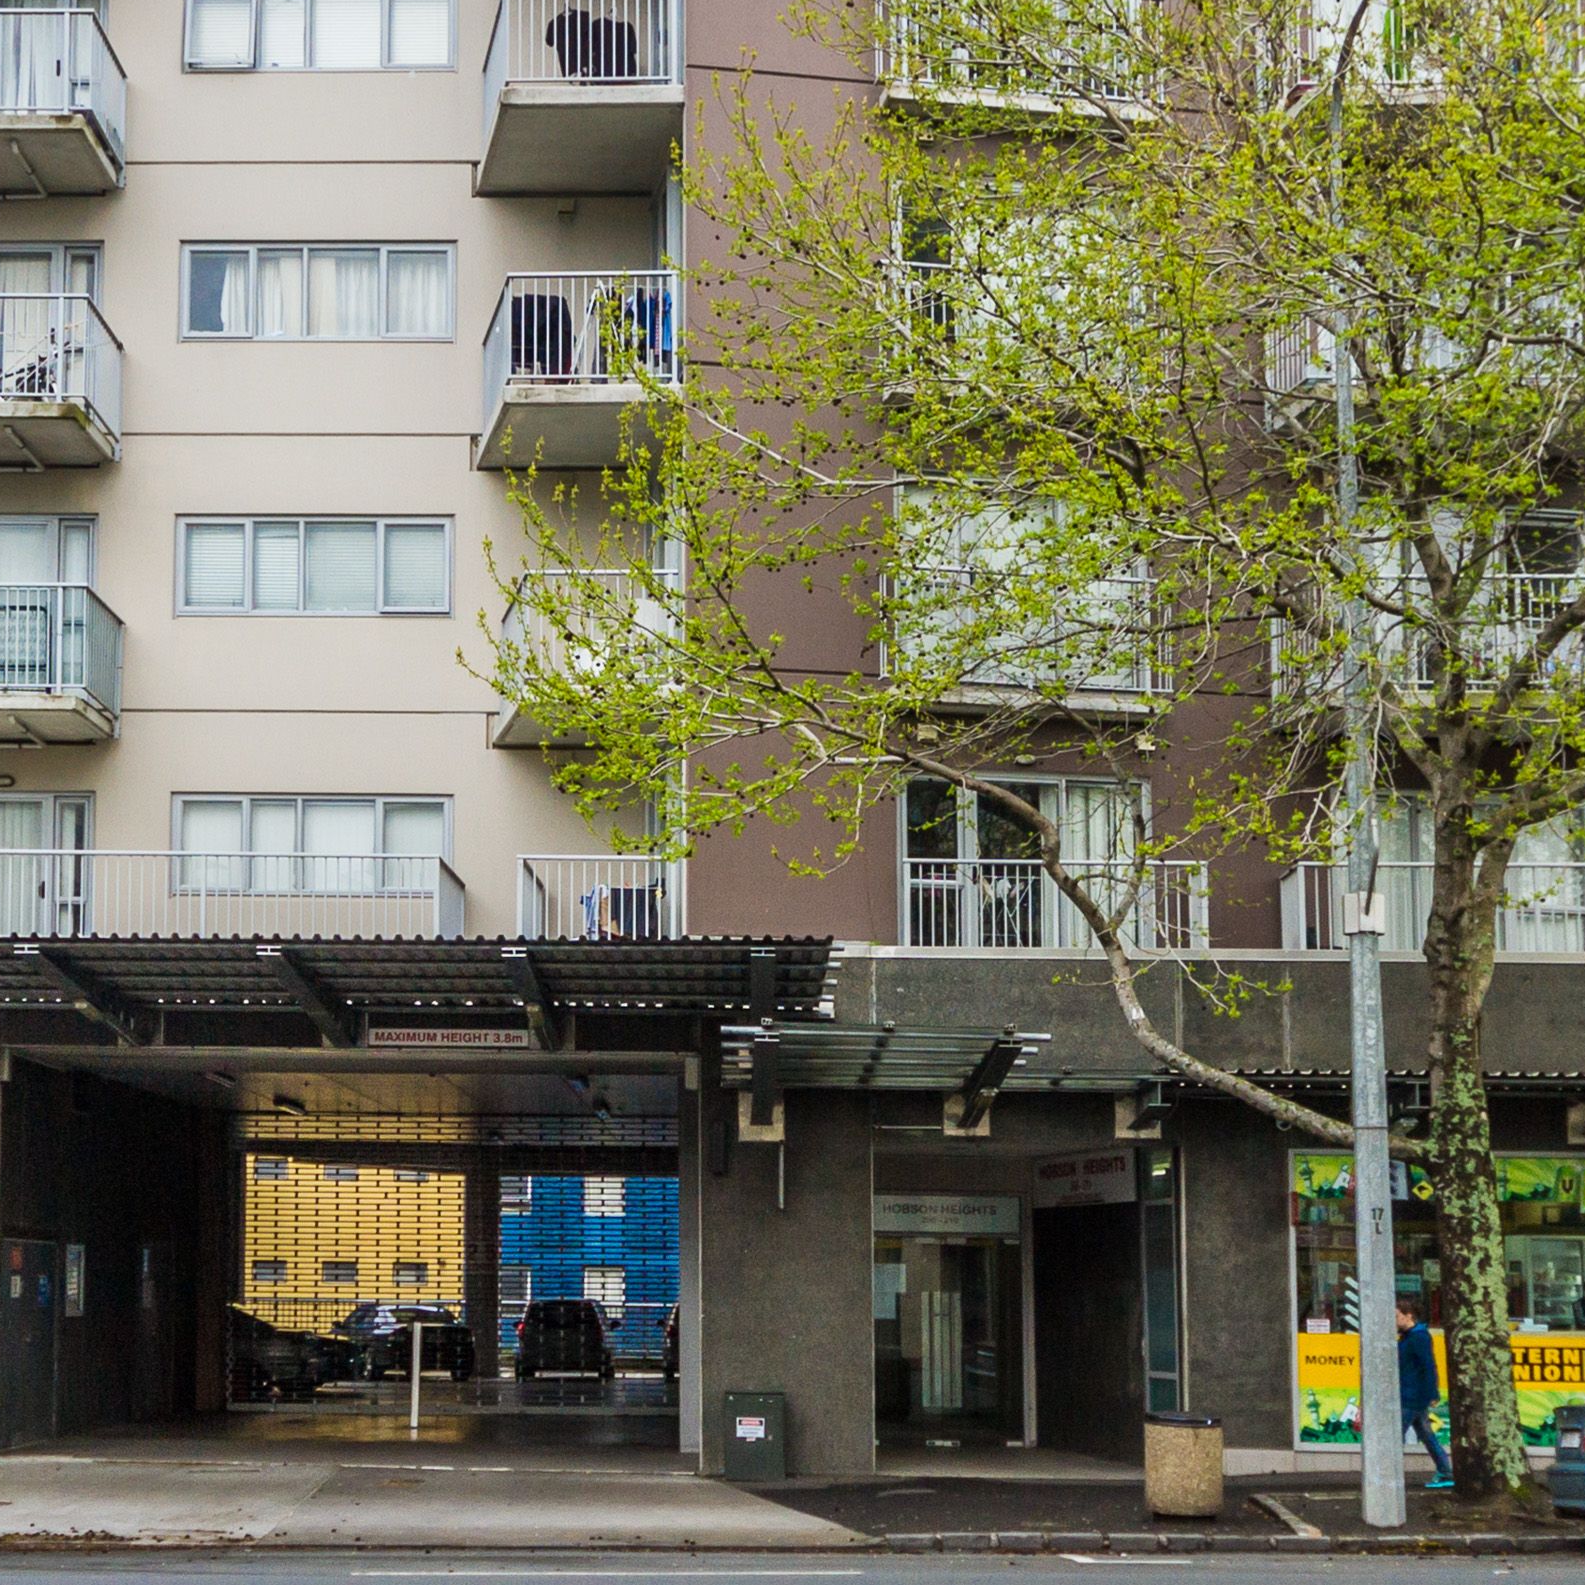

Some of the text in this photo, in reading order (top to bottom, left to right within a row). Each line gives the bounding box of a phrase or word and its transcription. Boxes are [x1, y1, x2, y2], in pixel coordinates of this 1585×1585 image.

[373, 1031, 523, 1044] MAXIMUM HEIGHT 3.8m
[882, 1203, 998, 1216] HOBSON HEIGHTS
[1305, 1355, 1356, 1366] MONEY
[1511, 1348, 1582, 1365] TERN
[1513, 1364, 1582, 1382] NION
